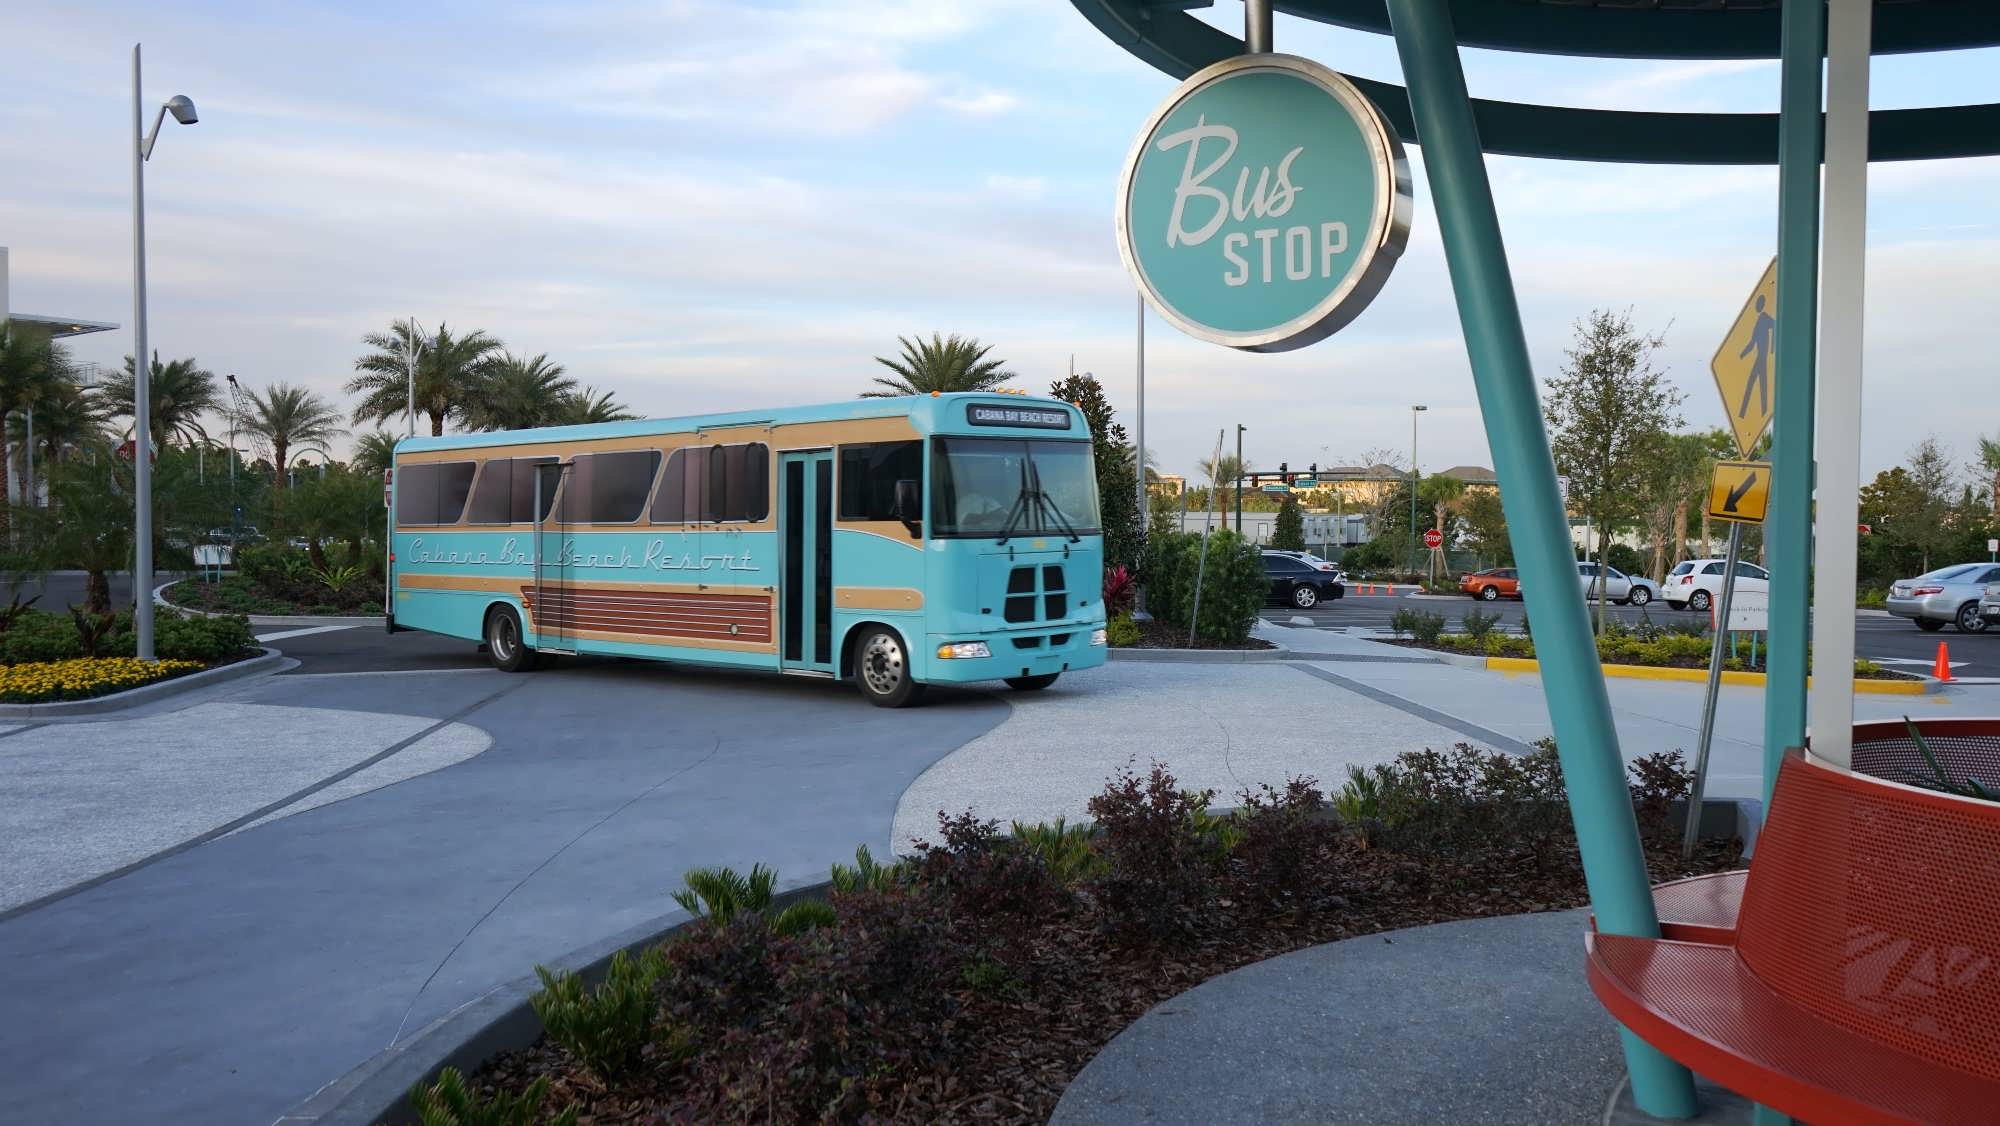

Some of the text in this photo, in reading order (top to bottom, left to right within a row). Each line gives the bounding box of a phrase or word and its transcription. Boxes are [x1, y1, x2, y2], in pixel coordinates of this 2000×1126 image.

[1156, 112, 1304, 249] Bus
[1223, 221, 1348, 287] STOP
[975, 409, 1066, 425] CABANA BAY BEACH RESORT
[408, 537, 490, 564] Cabana
[556, 538, 640, 568] Beach
[643, 539, 760, 571] Resort
